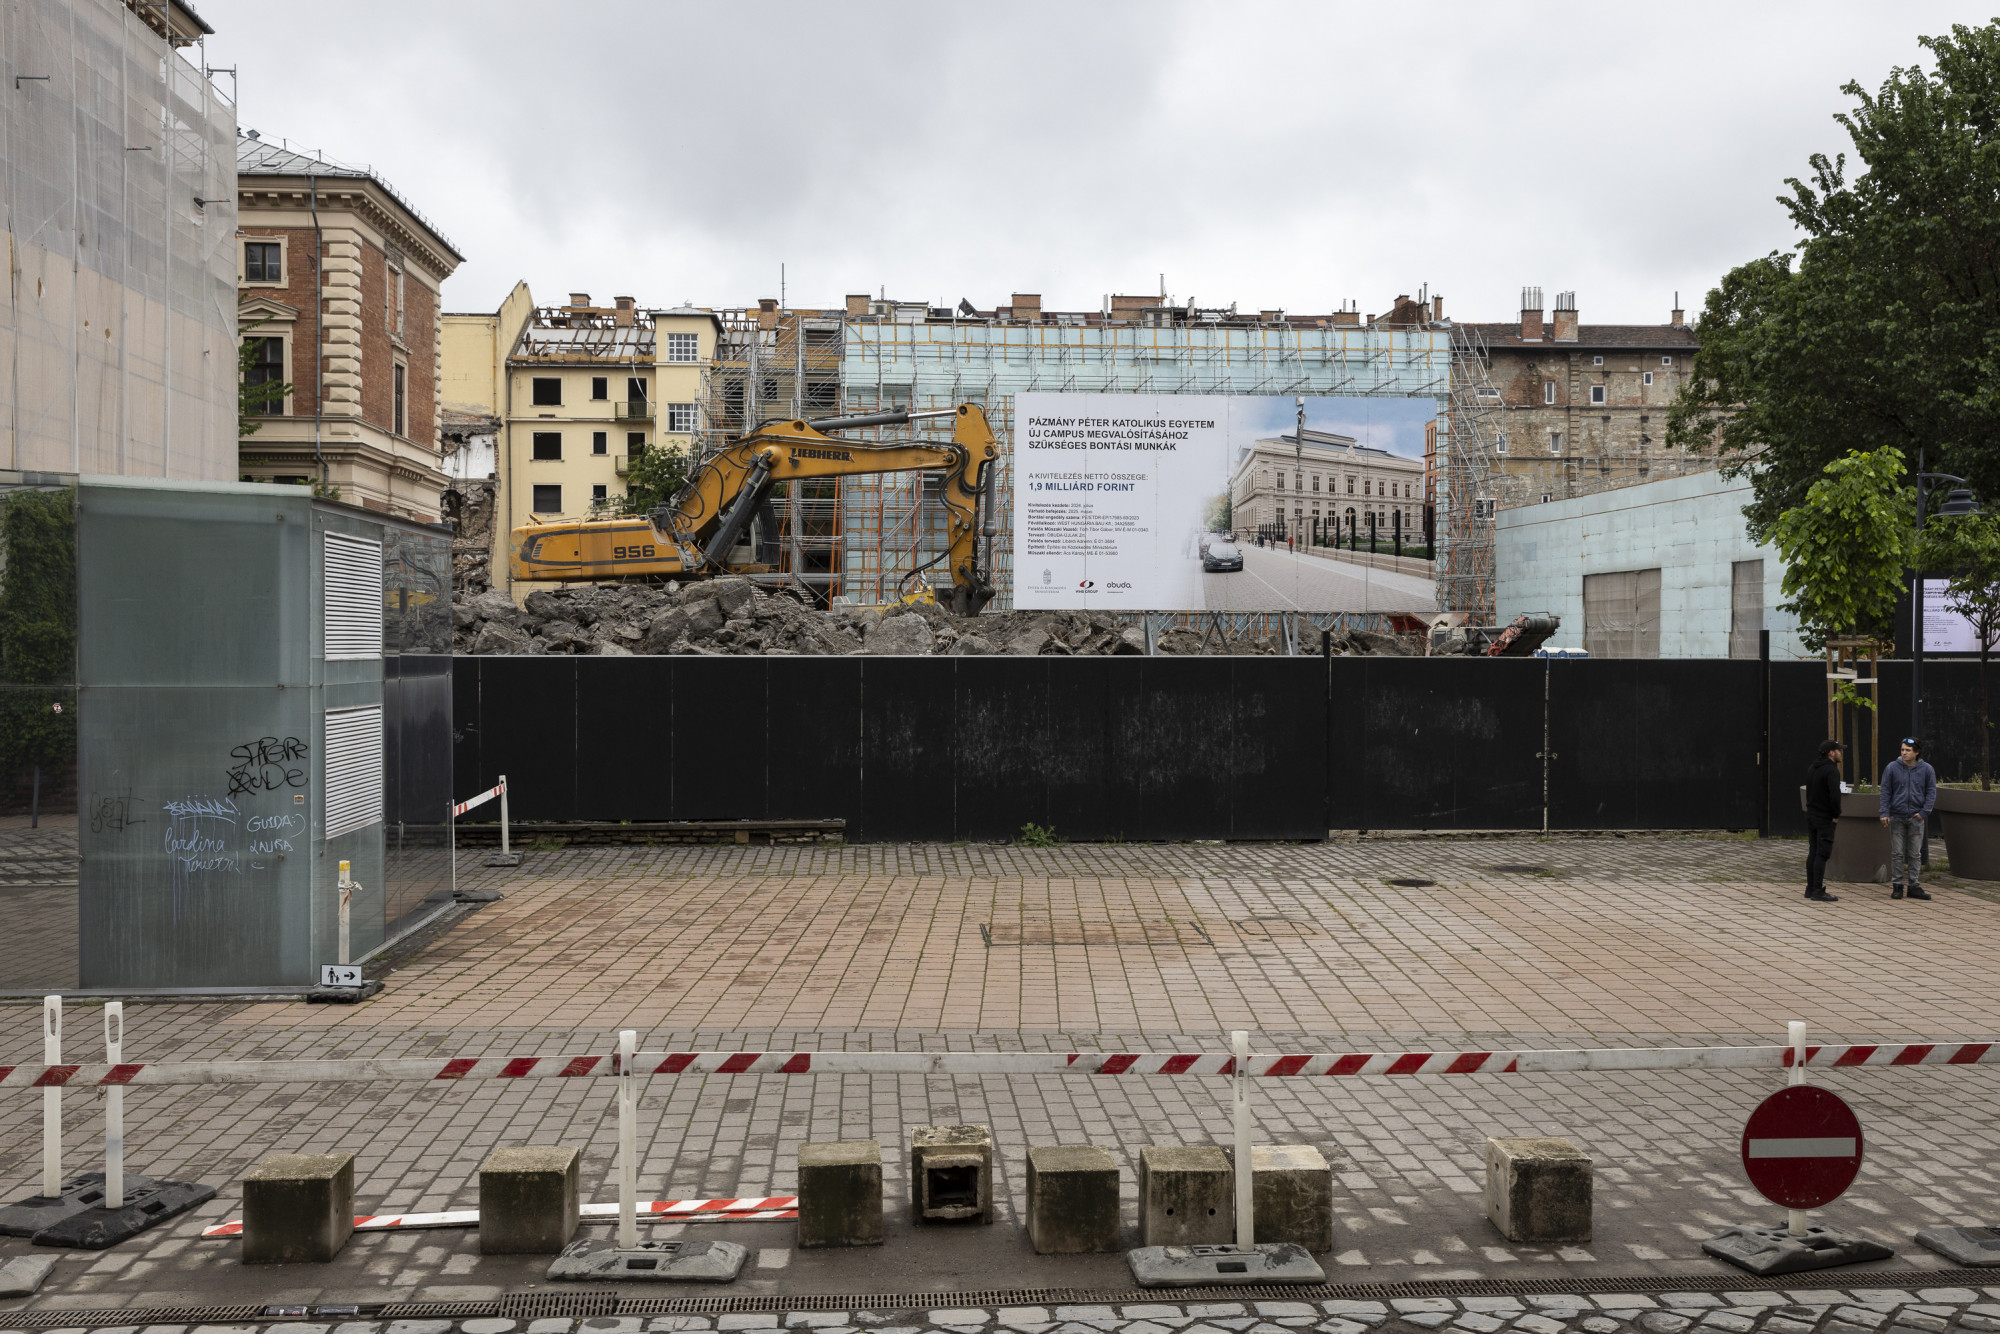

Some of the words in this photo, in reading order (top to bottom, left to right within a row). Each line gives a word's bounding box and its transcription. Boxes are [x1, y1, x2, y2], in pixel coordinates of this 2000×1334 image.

[1028, 416, 1076, 427] PÁZMÁNY
[1078, 417, 1109, 427] PÉTER
[1112, 419, 1166, 428] KATOLIKUS
[1168, 420, 1215, 429] EGYETEM
[1028, 428, 1041, 438] ÚJ
[1043, 430, 1084, 438] CAMPUS
[1087, 428, 1188, 440] MEGVALÓSÍTÁSÁHOZ
[1028, 439, 1087, 450] SZÜKSÉGES
[1090, 440, 1132, 450] BONTÁSI
[1135, 441, 1177, 451] MUNKÁK
[791, 448, 850, 462] LIEBHERR
[1035, 471, 1082, 480] KIVITELEZÉS
[1084, 472, 1109, 480] NETTÓ
[1110, 472, 1148, 480] ÖSSZEGE:
[1029, 482, 1042, 491] 1,9
[1045, 481, 1094, 491] MILLIÁRD
[1097, 482, 1135, 491] FORINT
[614, 545, 655, 559] 956
